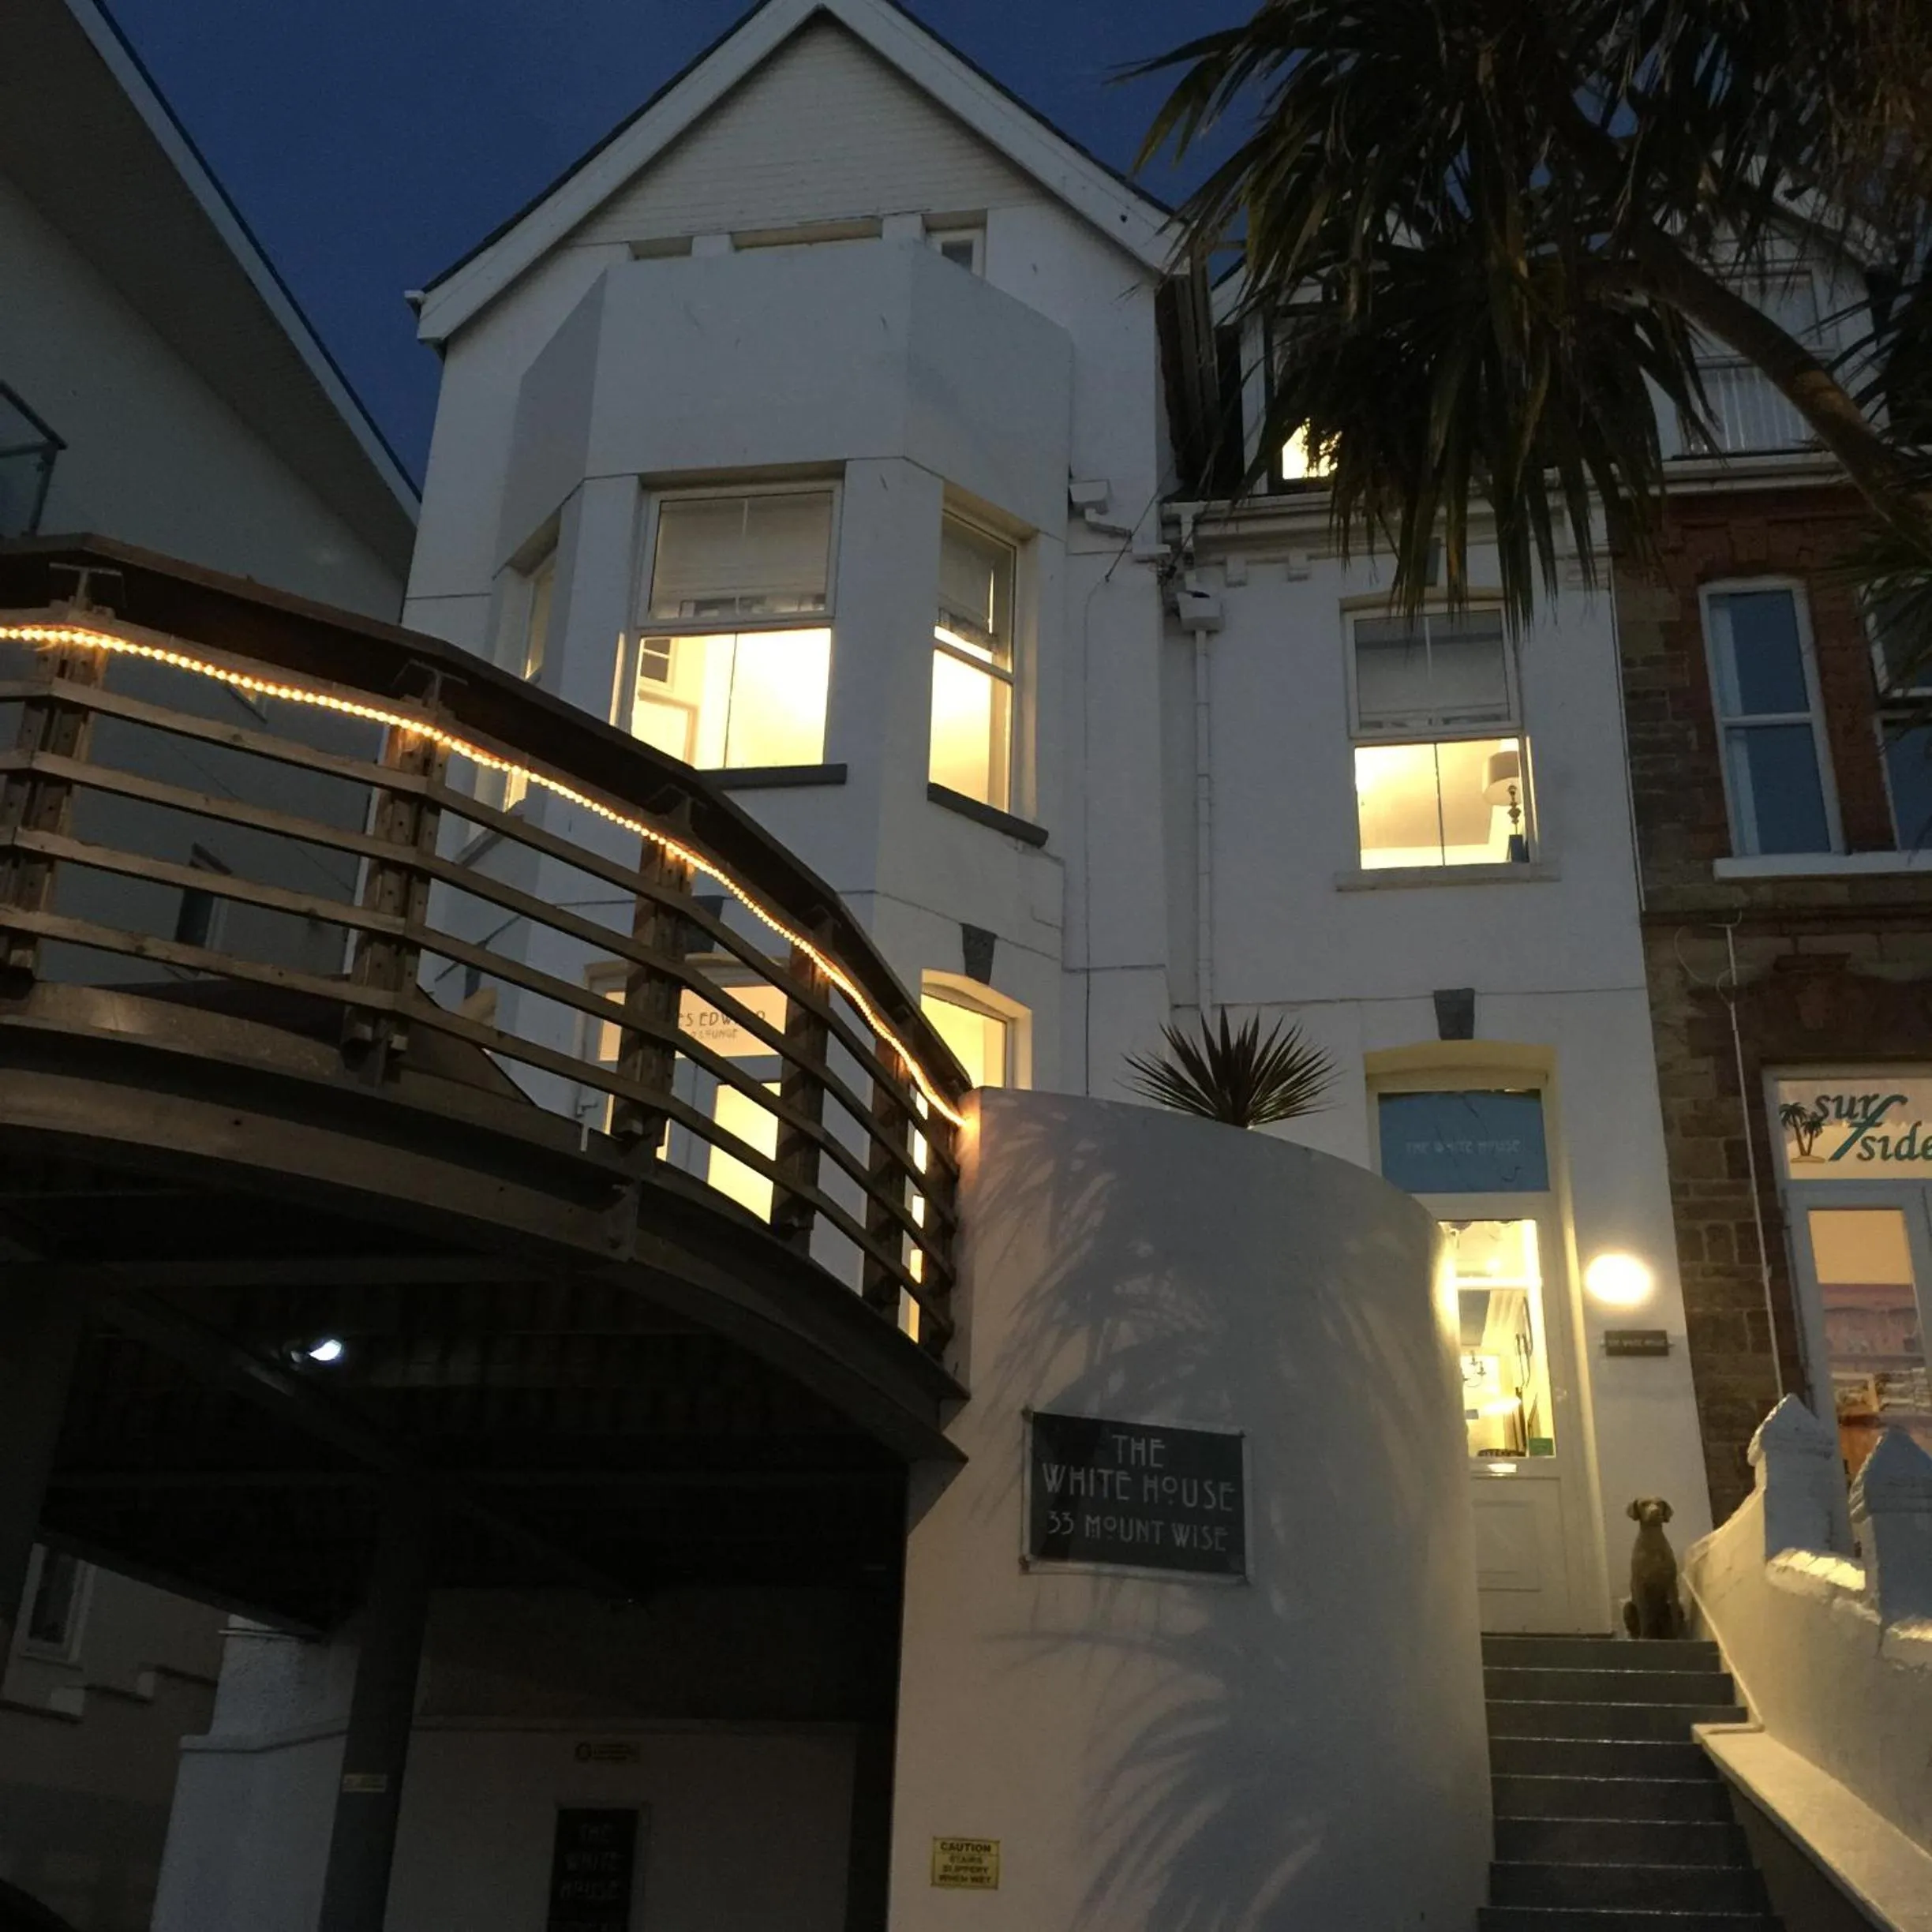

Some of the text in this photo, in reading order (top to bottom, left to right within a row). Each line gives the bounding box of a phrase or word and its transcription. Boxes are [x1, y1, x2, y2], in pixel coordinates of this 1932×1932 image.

[1112, 1434, 1165, 1468] THE
[1043, 1463, 1235, 1512] WHITE HOUSE
[1084, 1514, 1165, 1545] MOUNT
[1171, 1522, 1229, 1552] WISE
[940, 1841, 992, 1852] CAUTION
